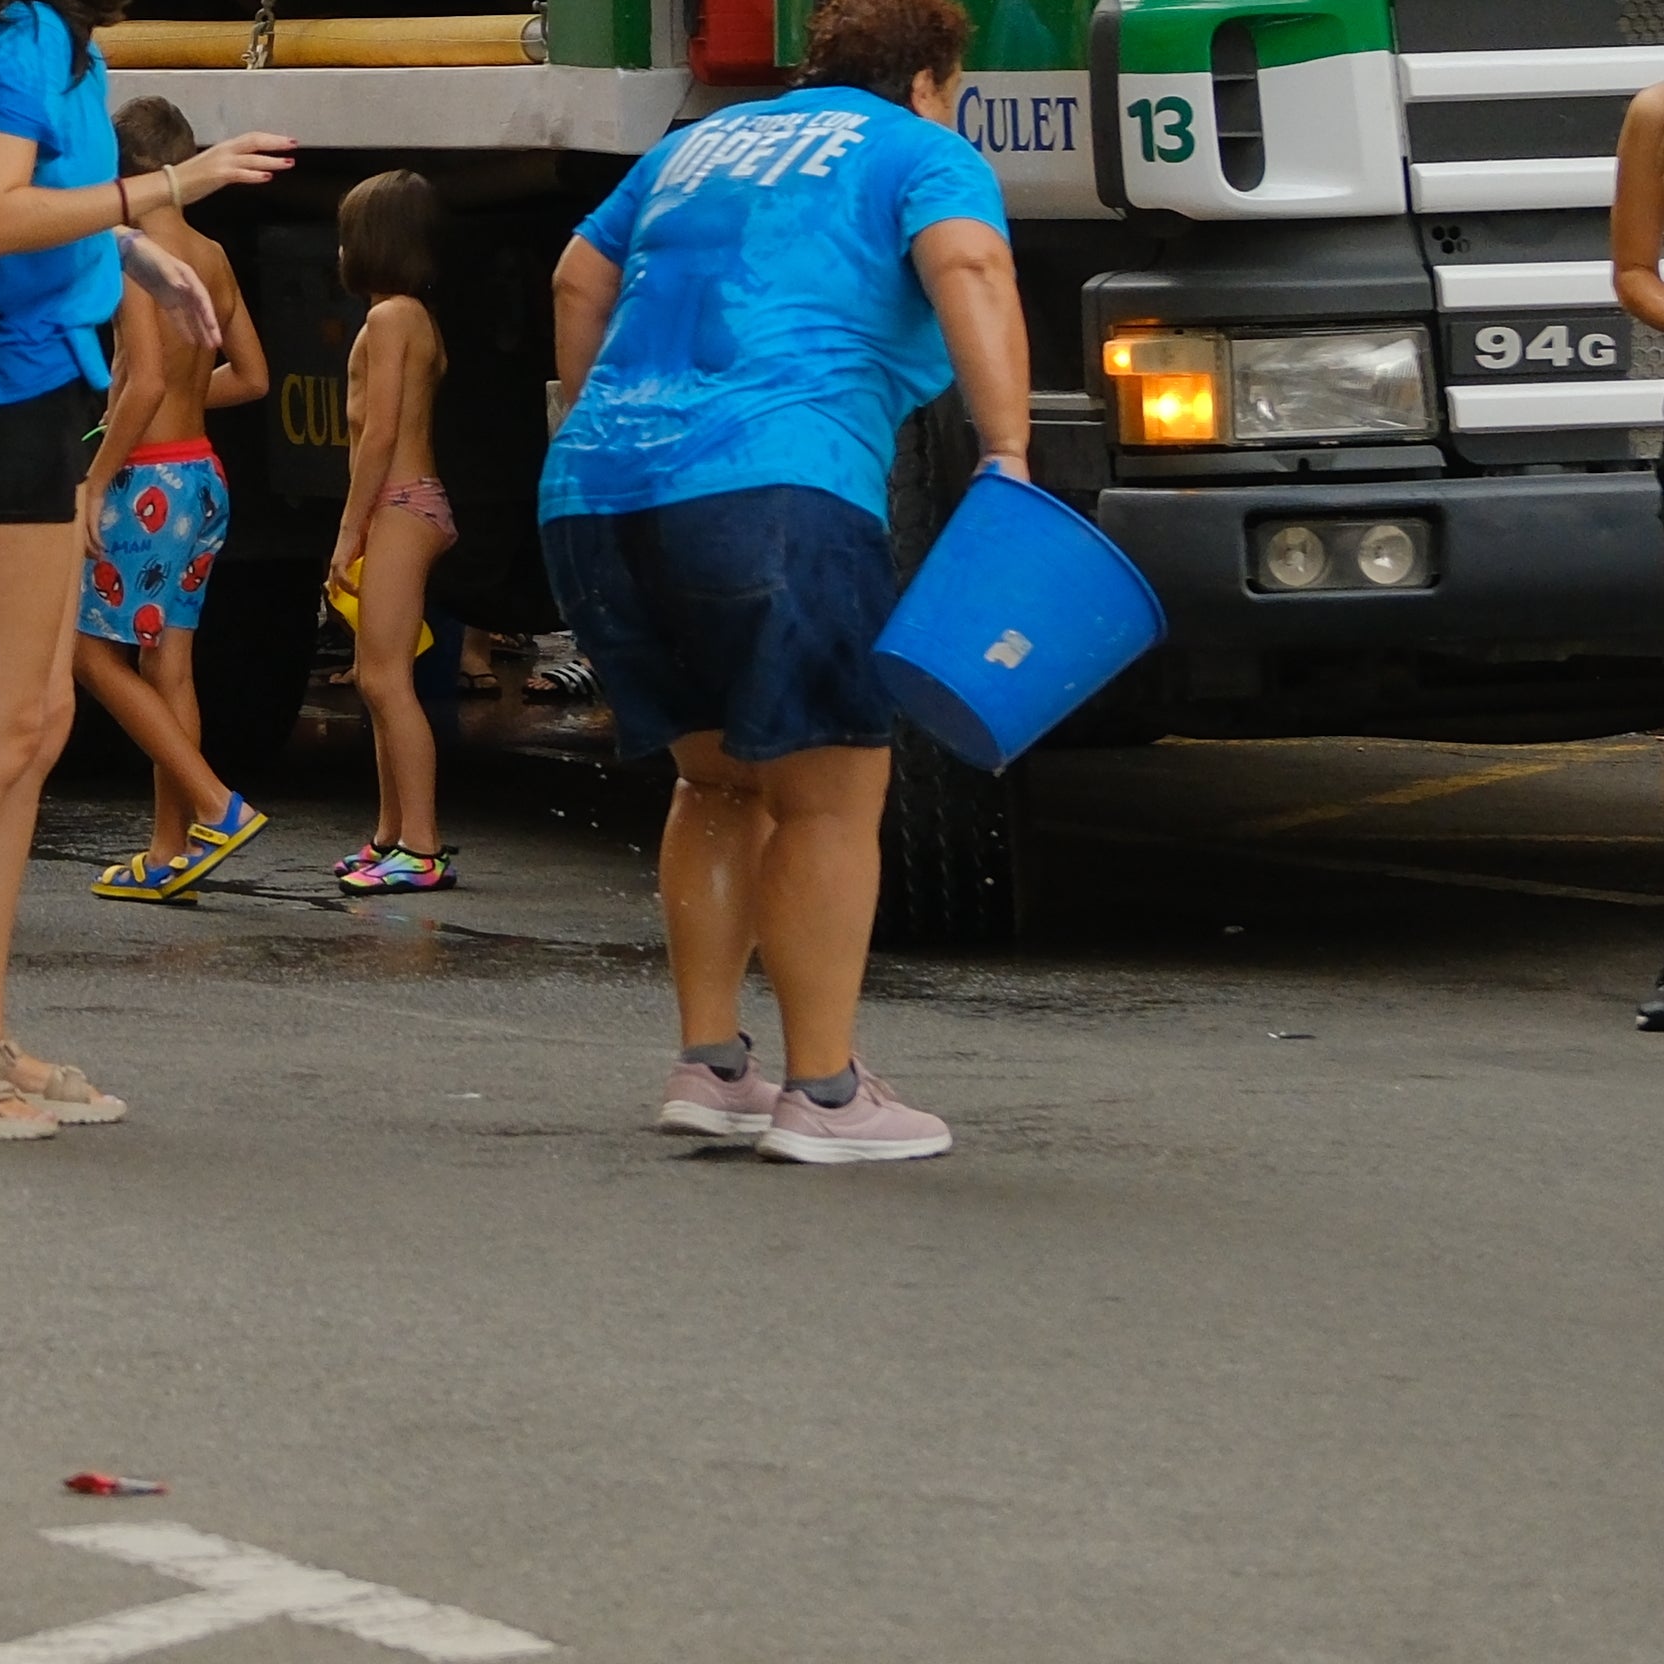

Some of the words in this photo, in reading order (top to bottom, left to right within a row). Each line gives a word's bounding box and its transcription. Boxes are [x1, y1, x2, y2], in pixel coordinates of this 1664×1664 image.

[957, 86, 1078, 152] CULET
[1127, 96, 1195, 163] 13
[1475, 325, 1617, 370] 94G
[281, 373, 349, 447] CUL
